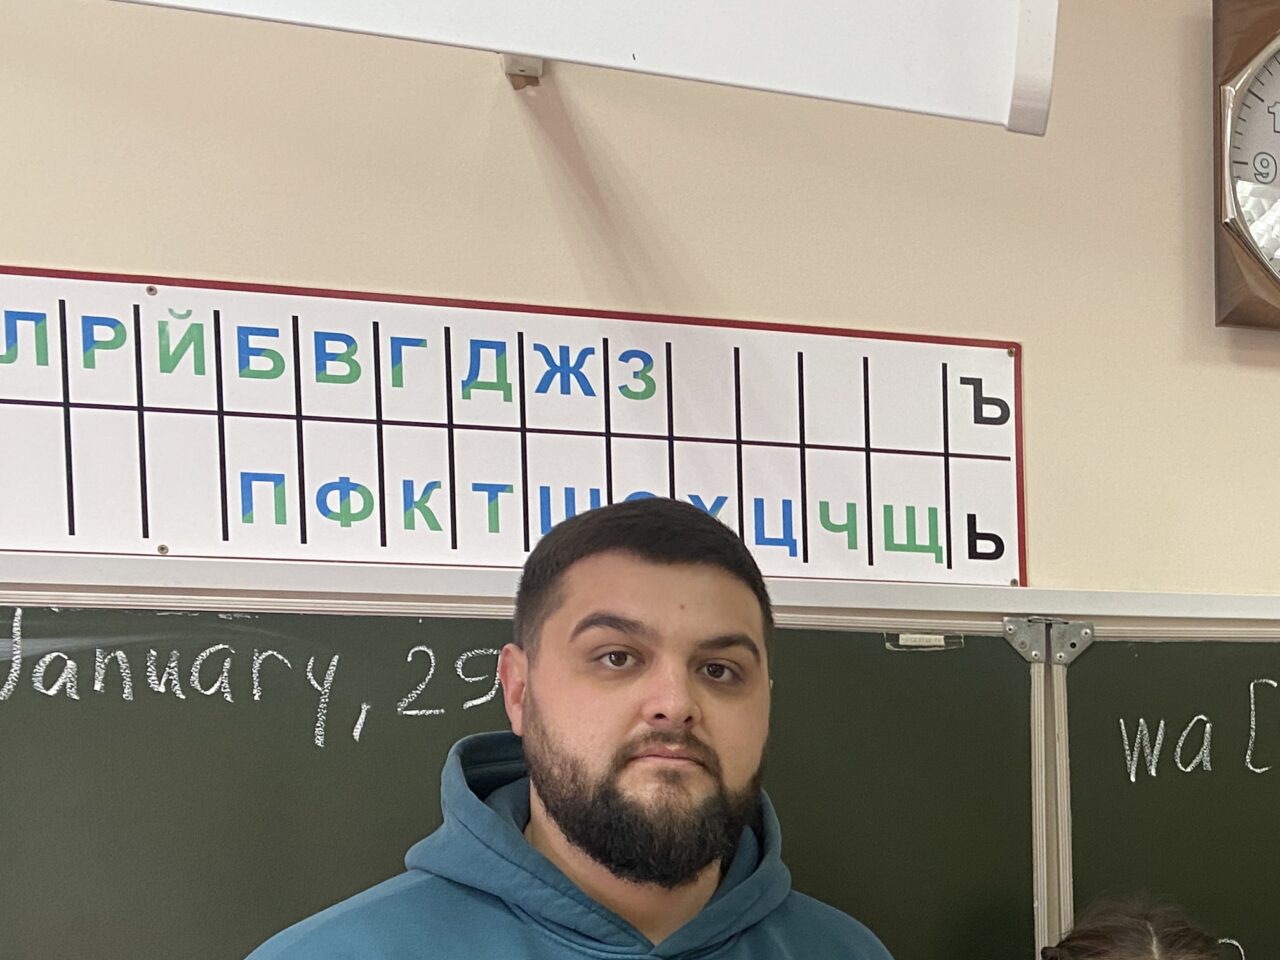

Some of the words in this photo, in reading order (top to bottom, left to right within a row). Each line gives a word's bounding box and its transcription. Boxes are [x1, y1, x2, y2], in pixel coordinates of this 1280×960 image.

[1253, 152, 1278, 184] 9
[0, 310, 49, 367] Л
[157, 307, 207, 376] Й
[237, 325, 286, 380] Б
[314, 331, 362, 385] В
[390, 336, 428, 388] Г
[461, 338, 513, 403] Д
[533, 342, 597, 398] Ж
[617, 349, 657, 401] З
[960, 376, 1012, 426] Ъ
[240, 471, 287, 525] П
[315, 476, 376, 529] Ф
[402, 479, 444, 532] К
[471, 482, 515, 534] Т
[753, 497, 798, 558] Ц
[818, 500, 858, 551] Ч
[883, 504, 943, 564] Щ
[967, 513, 1006, 562] Ь
[1119, 713, 1213, 783] wa
